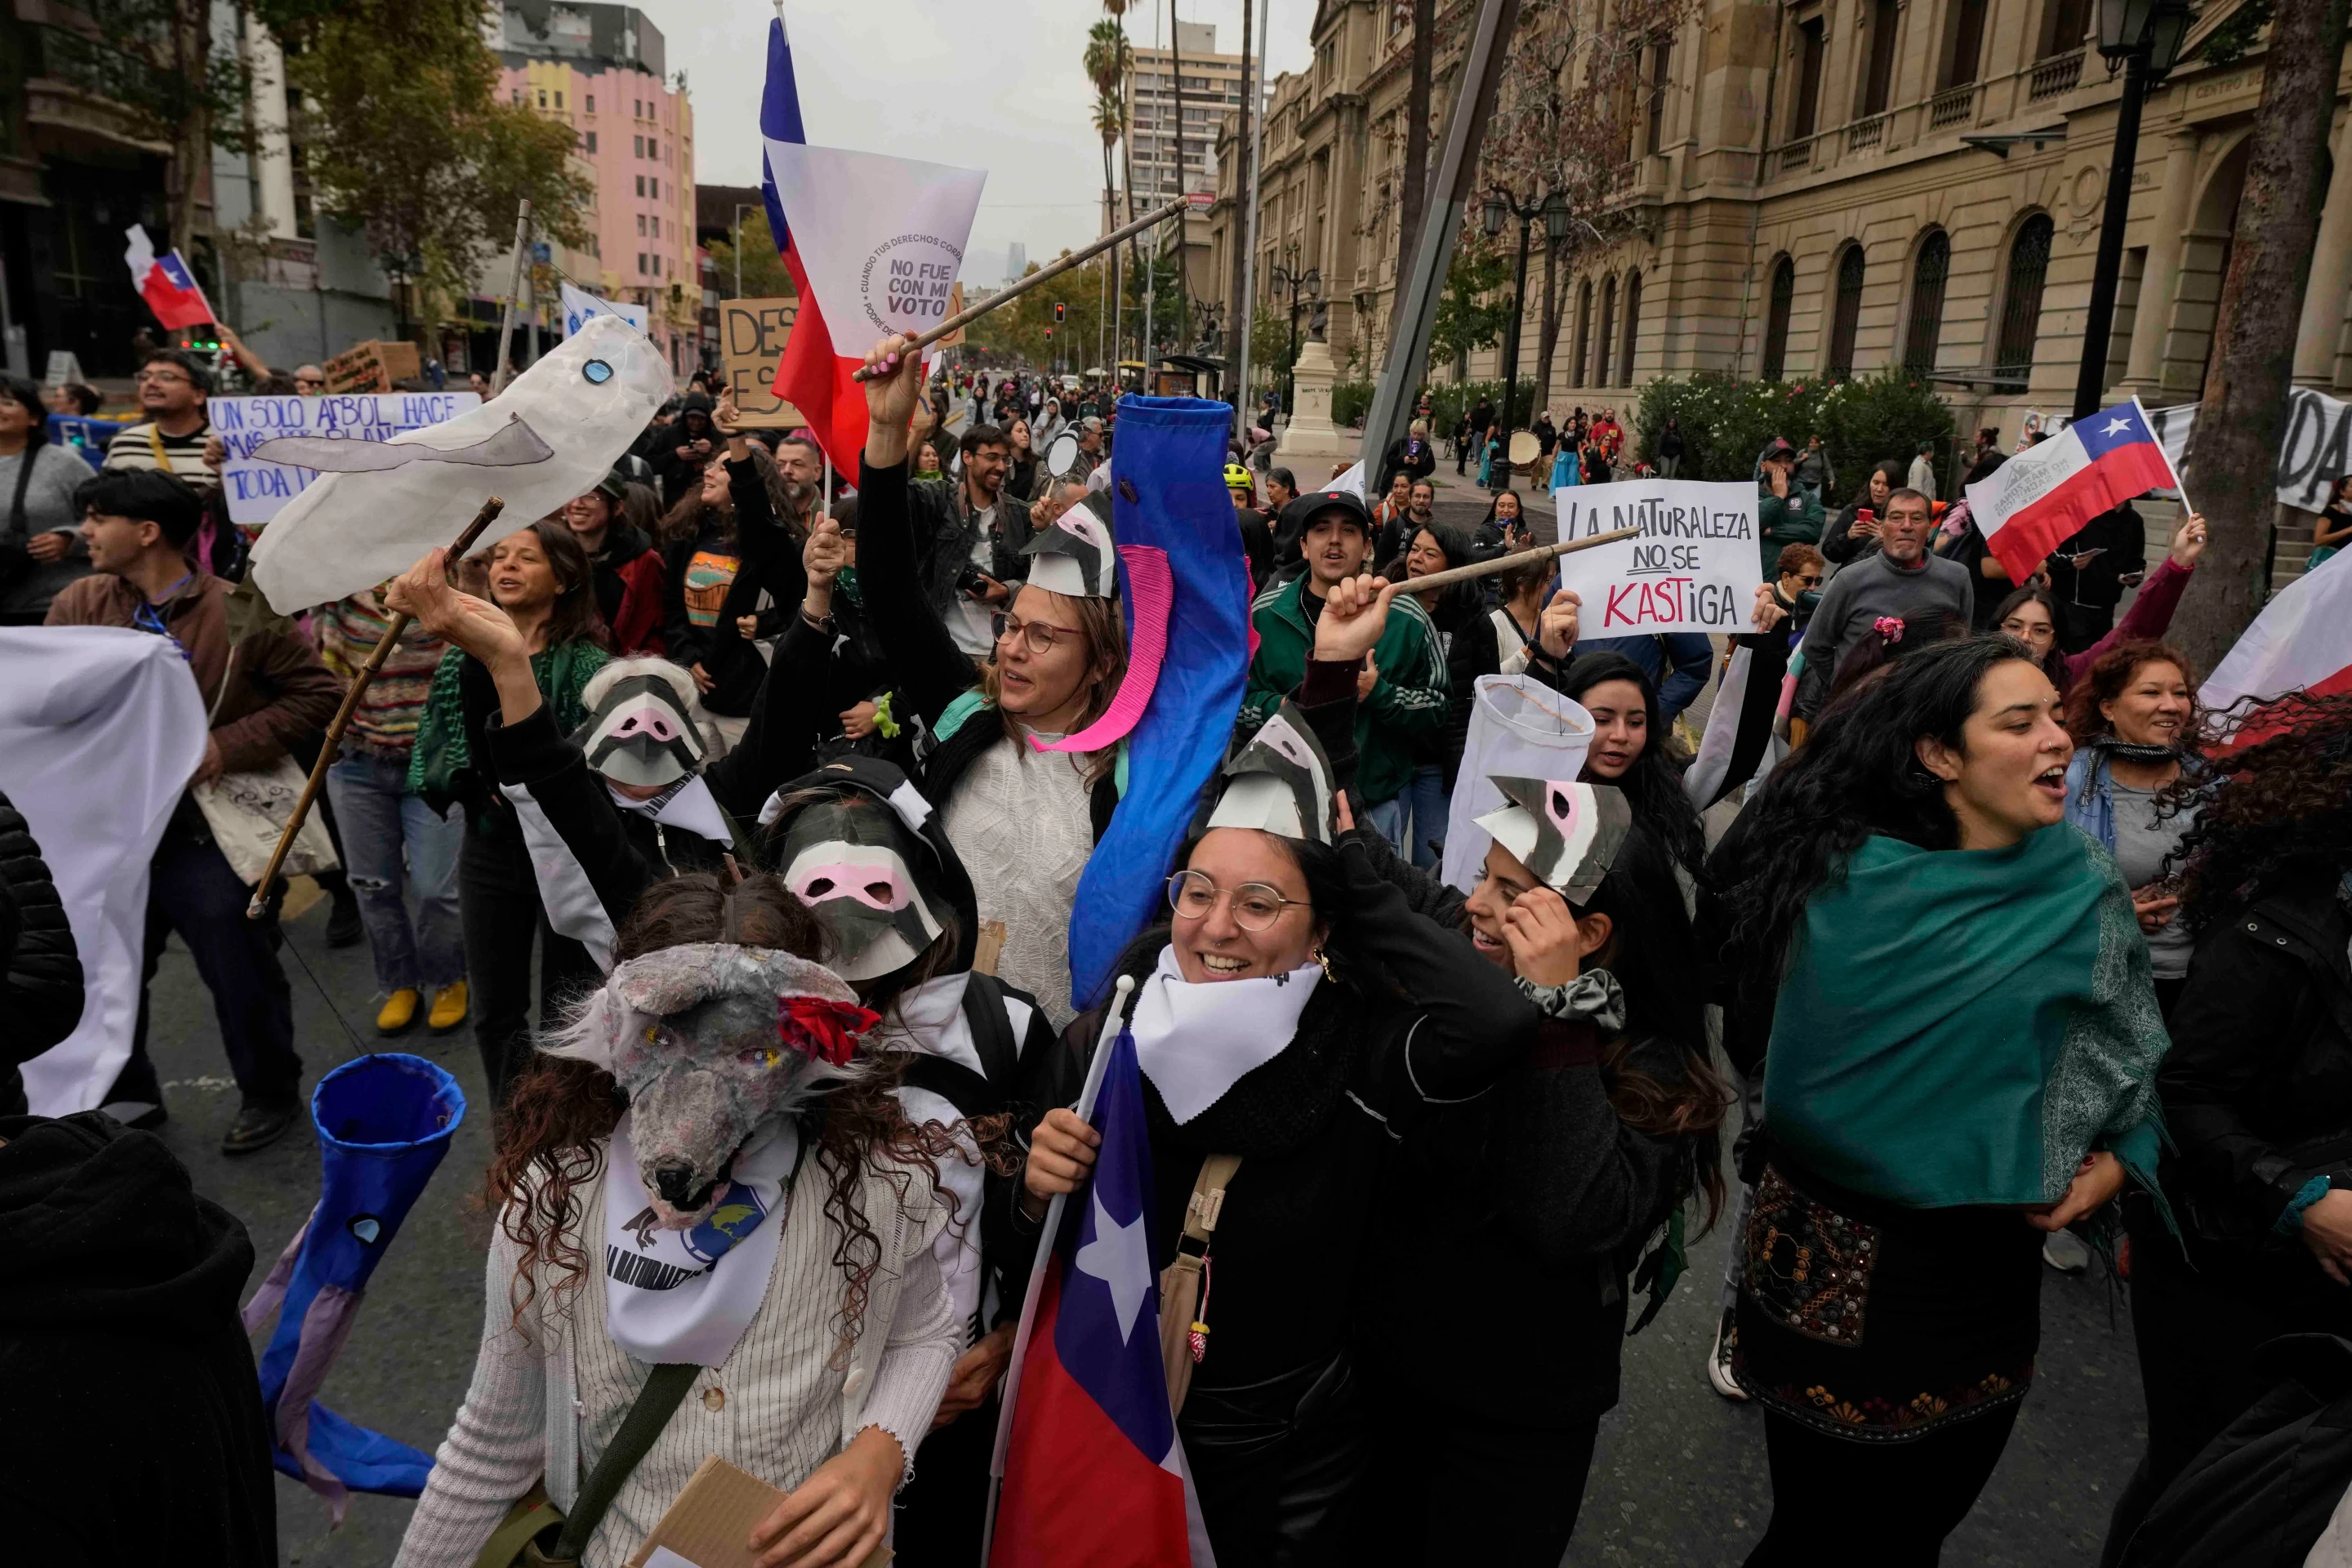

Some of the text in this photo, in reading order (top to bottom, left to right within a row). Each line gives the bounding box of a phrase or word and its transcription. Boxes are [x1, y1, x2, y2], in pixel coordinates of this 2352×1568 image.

[861, 256, 877, 292] CUANDO
[874, 242, 891, 257] TUS
[890, 234, 939, 247] DERECHOS
[890, 259, 951, 280] NO FUE
[889, 278, 948, 297] CON MI
[863, 302, 886, 328] PODRÉ
[888, 296, 946, 316] VOTO
[212, 401, 244, 431] UN
[250, 399, 305, 428] SOLO
[226, 468, 292, 501] TODA
[1613, 497, 1752, 541] NATURALEZA
[1633, 544, 1700, 570] NO SE
